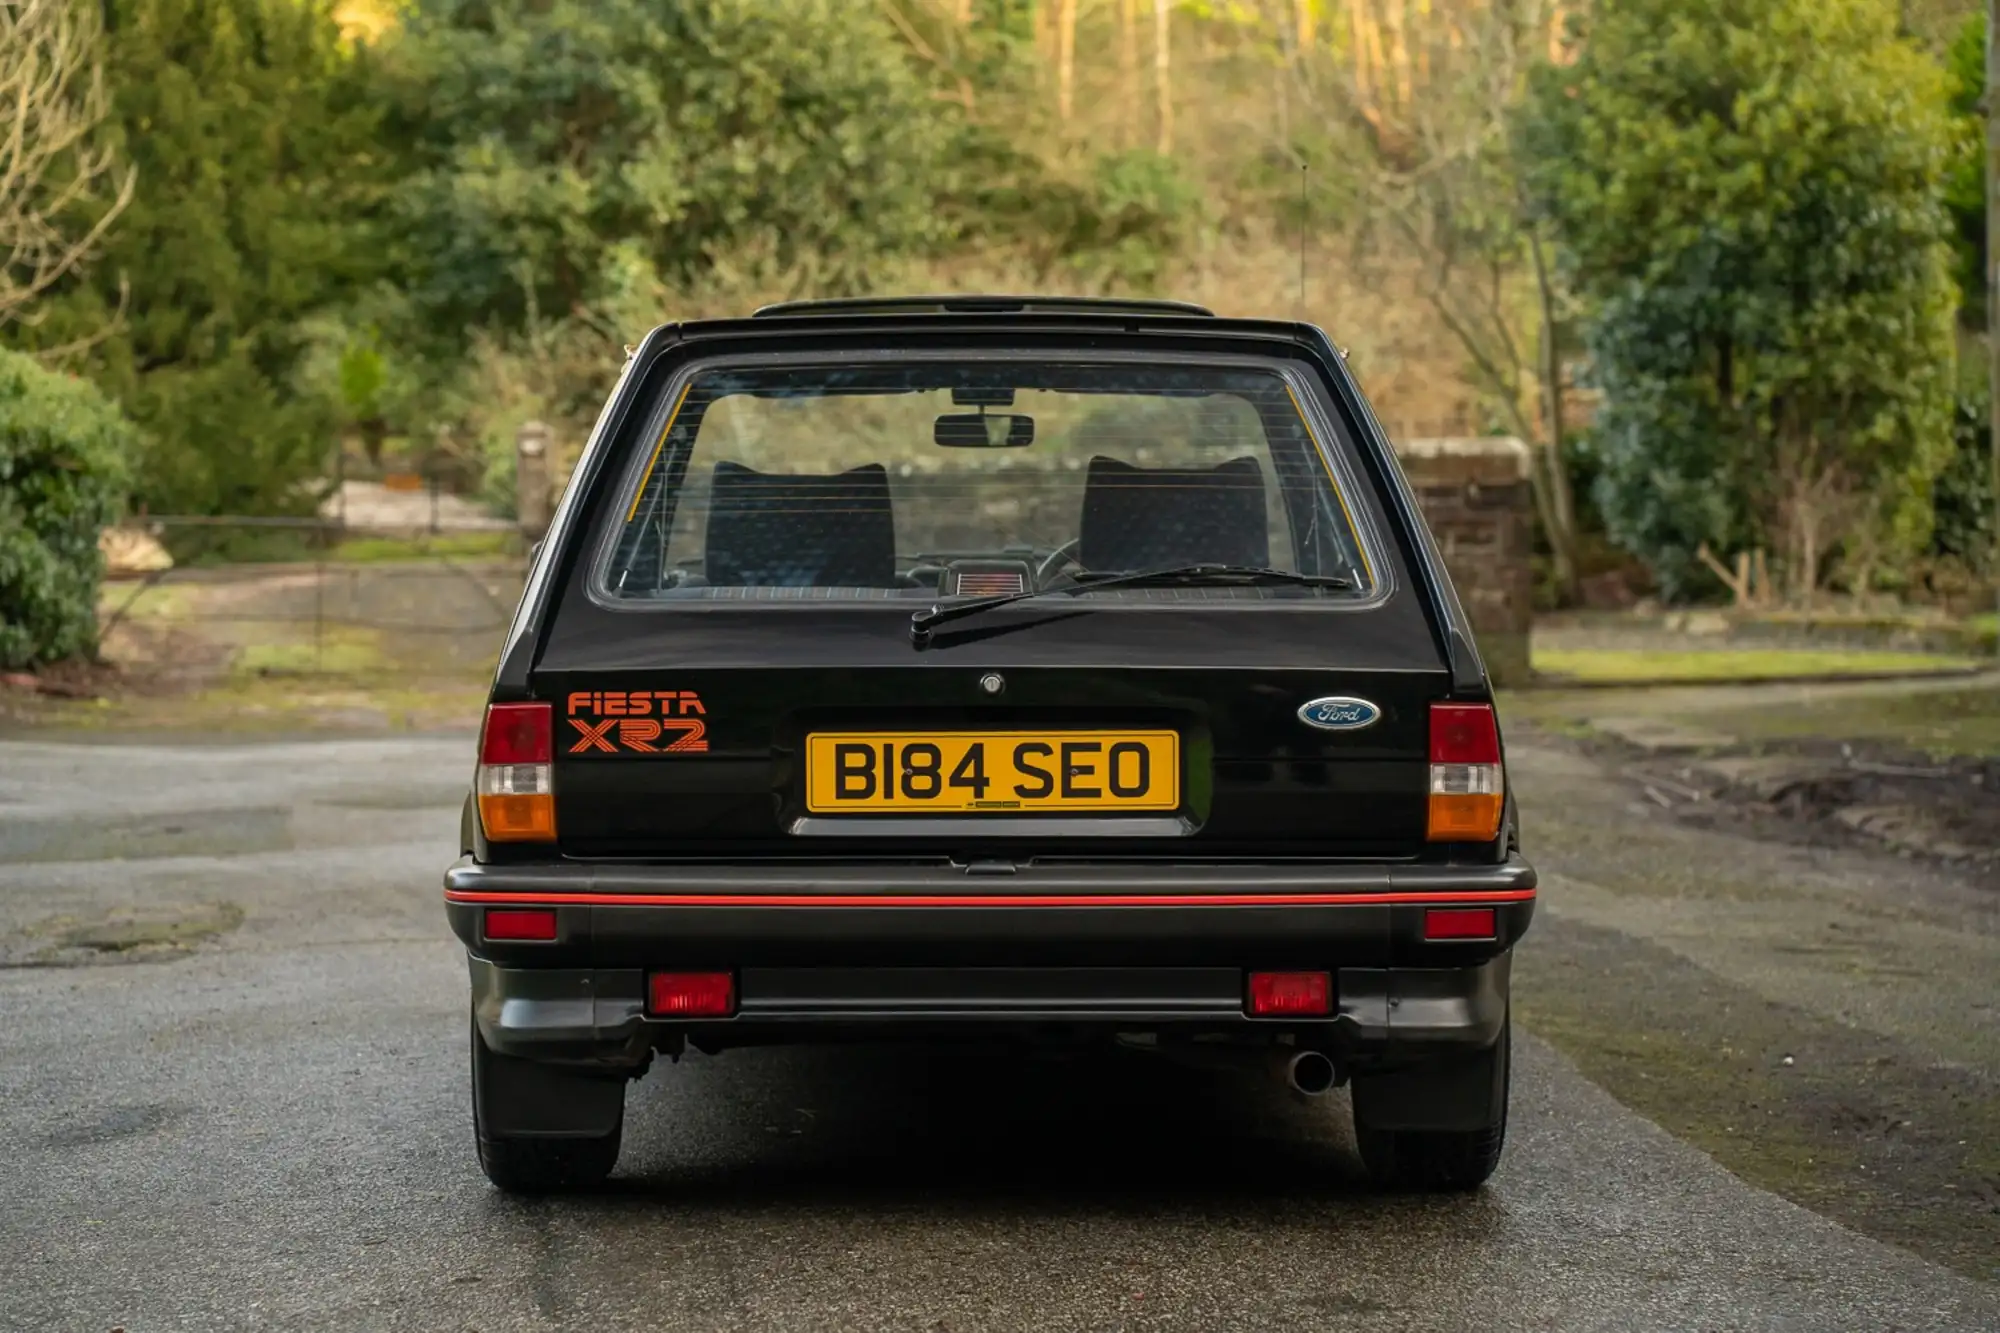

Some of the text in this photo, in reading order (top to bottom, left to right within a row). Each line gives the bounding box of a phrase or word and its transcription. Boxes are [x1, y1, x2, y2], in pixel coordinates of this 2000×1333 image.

[568, 691, 706, 715] FIESTA
[1318, 703, 1361, 721] Ford
[568, 719, 708, 752] XR2
[834, 742, 1150, 799] B184 SEO
